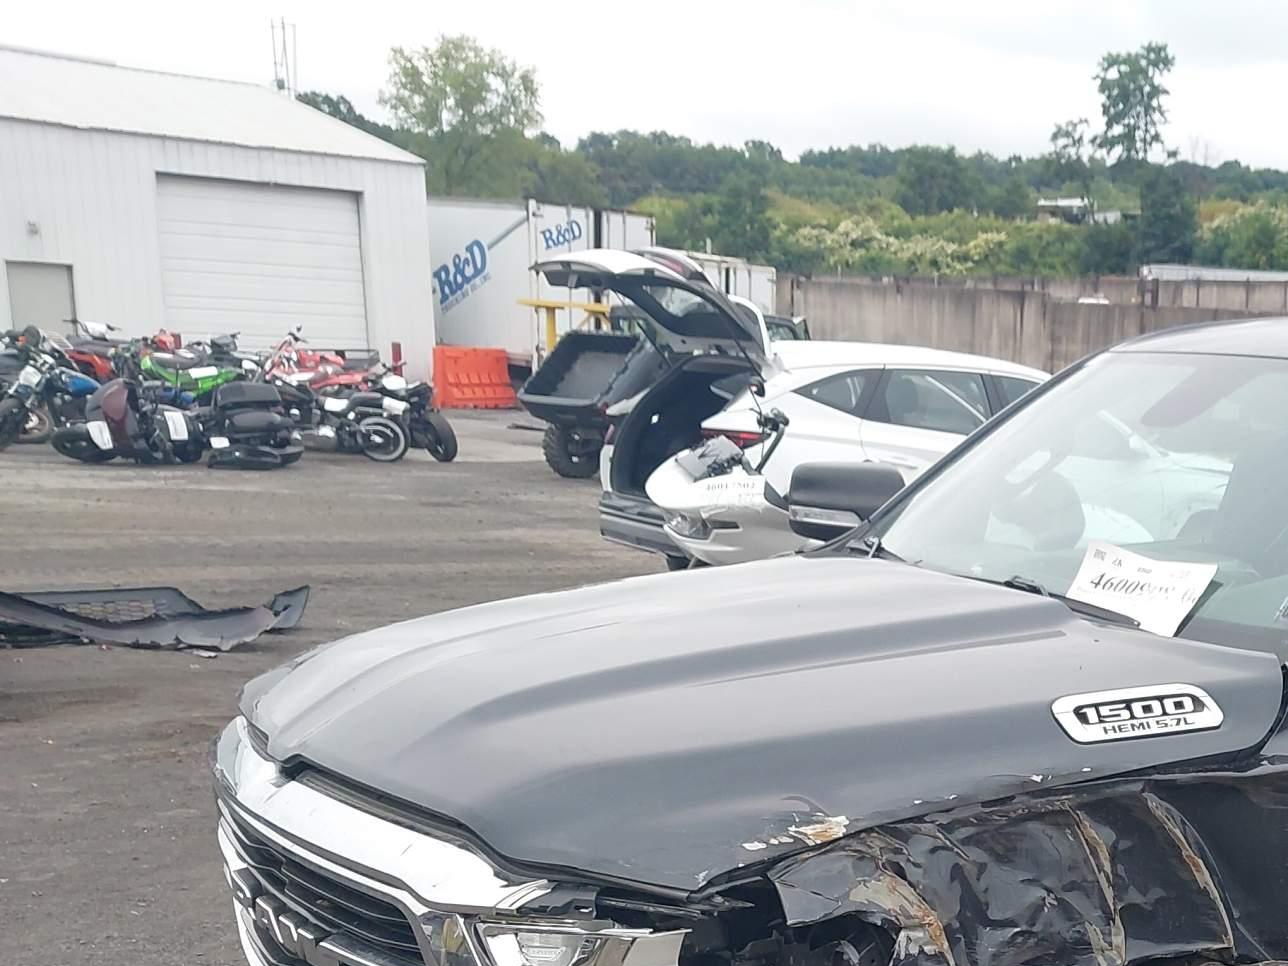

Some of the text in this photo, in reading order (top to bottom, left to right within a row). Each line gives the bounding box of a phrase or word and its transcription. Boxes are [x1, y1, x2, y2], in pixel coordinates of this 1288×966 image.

[540, 220, 582, 249] R&D
[432, 239, 487, 304] R&D
[1078, 696, 1194, 724] 1500
[1103, 716, 1196, 735] HEMI 5.7L
